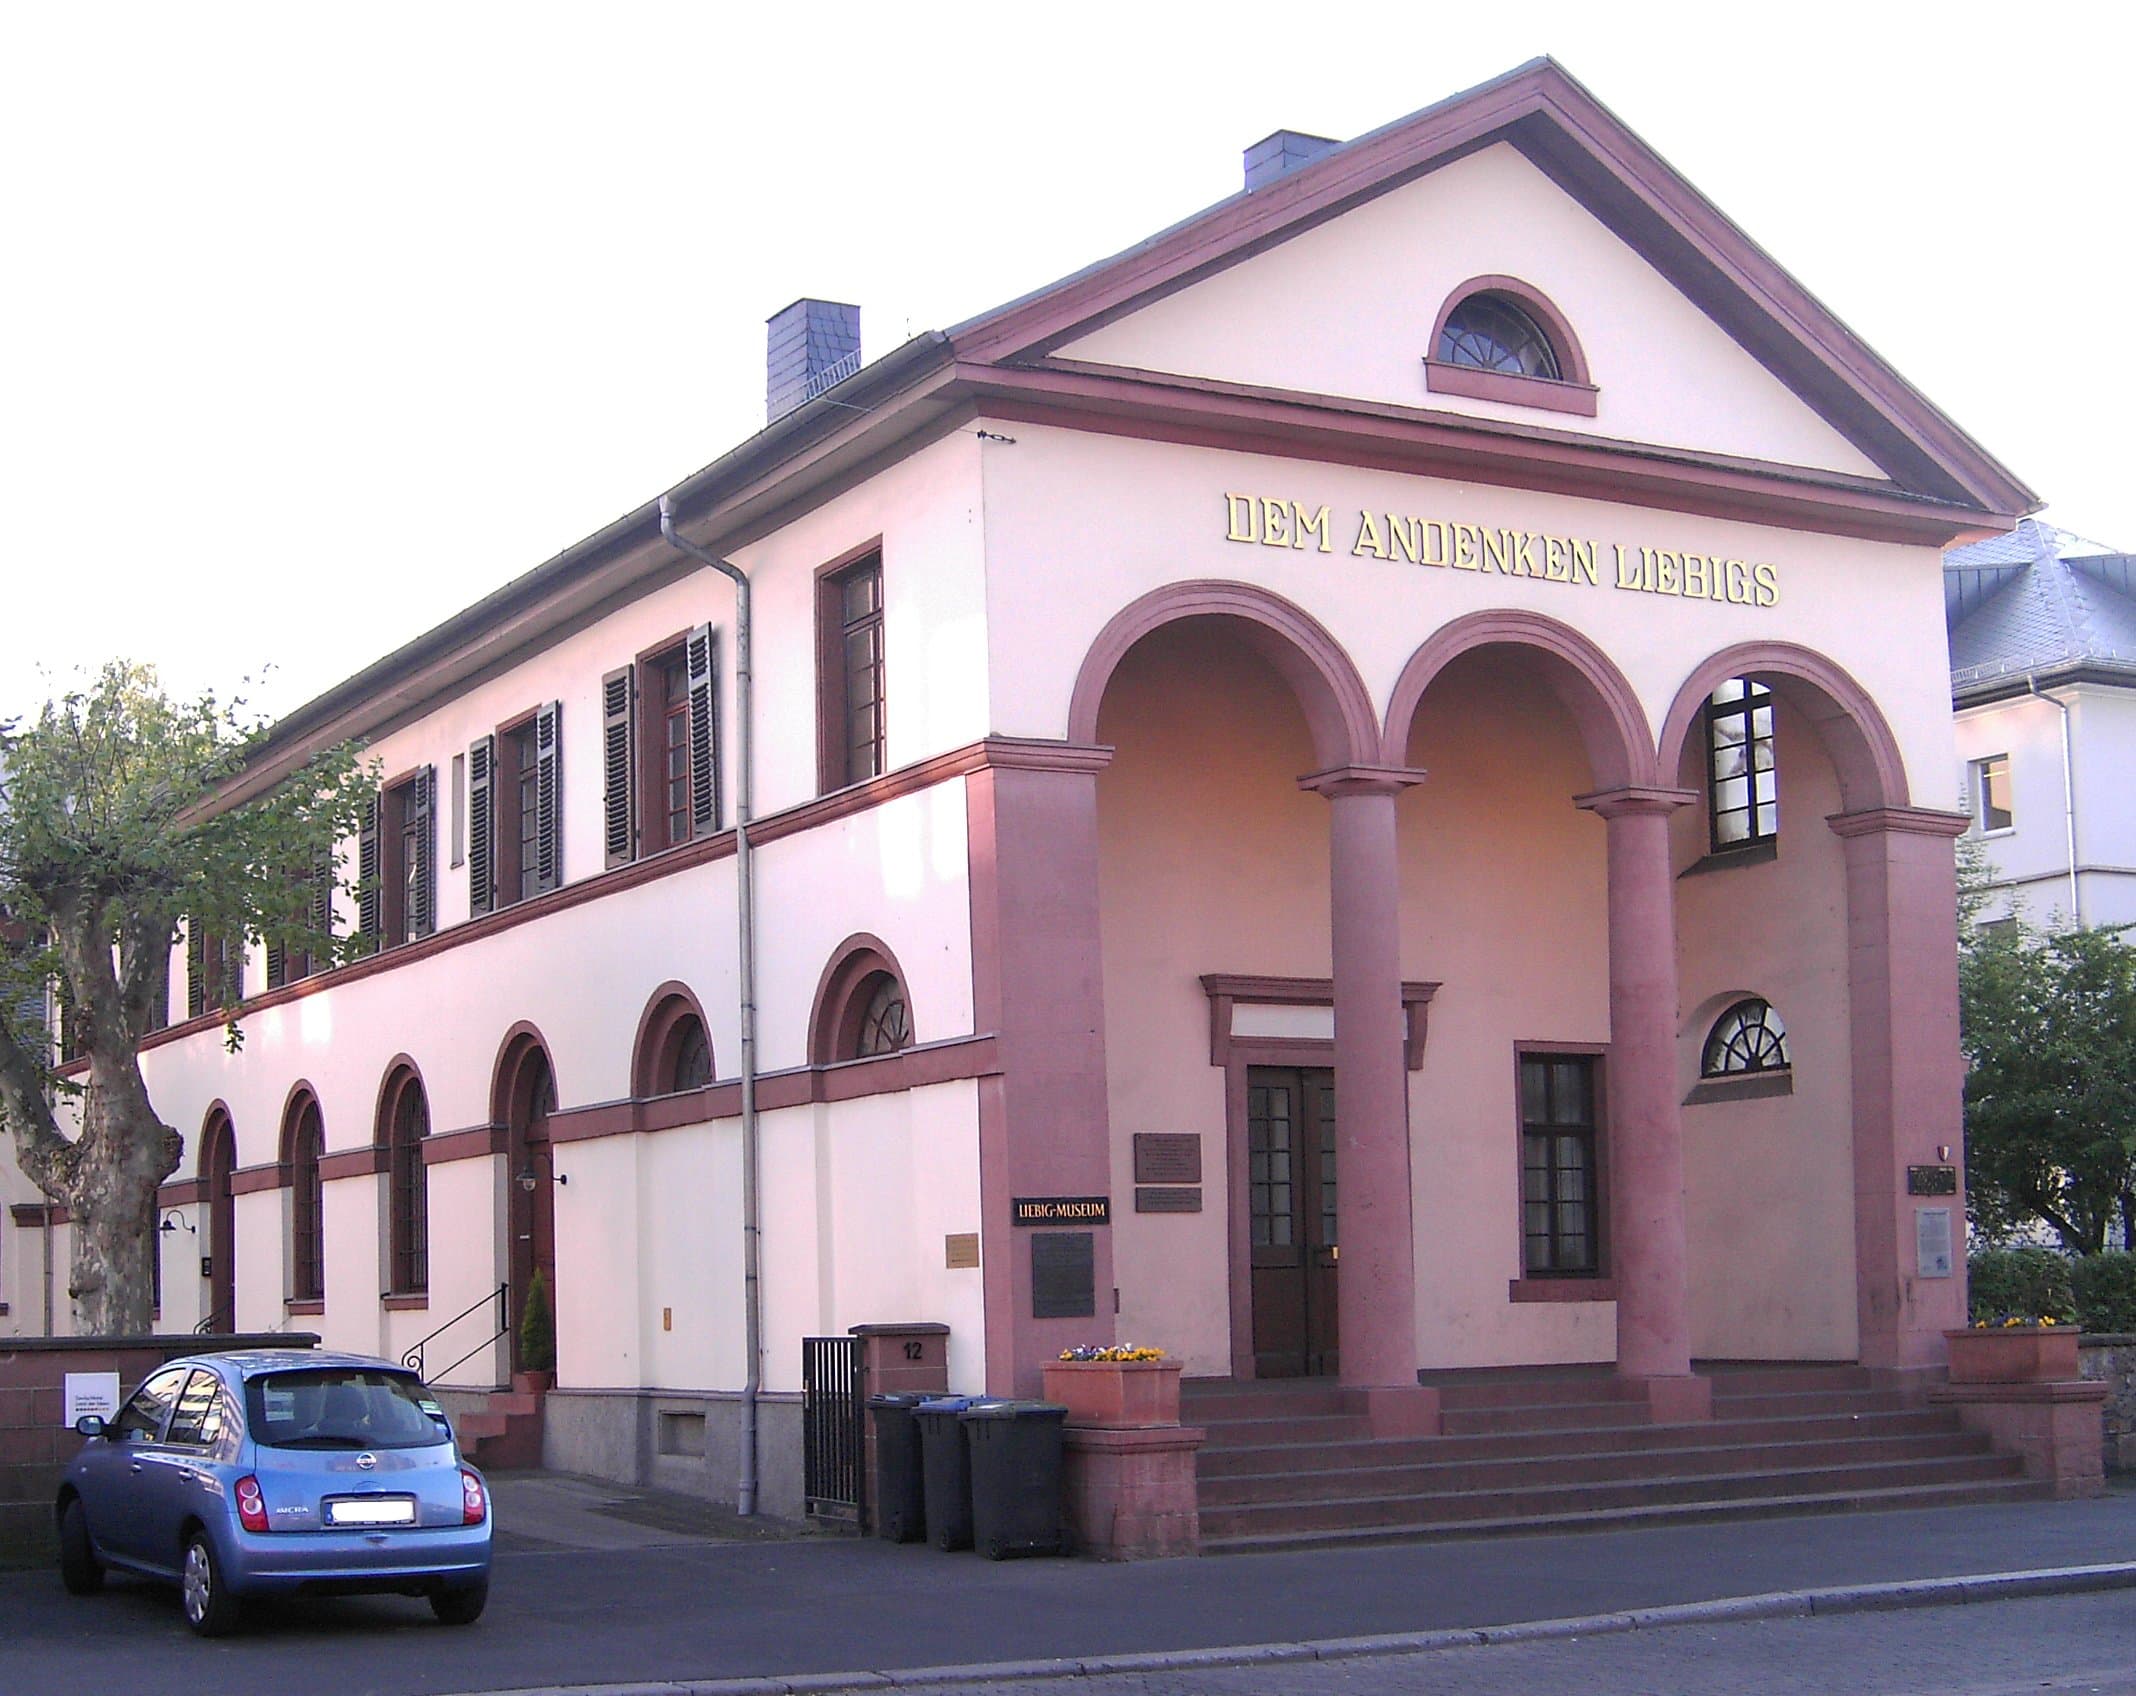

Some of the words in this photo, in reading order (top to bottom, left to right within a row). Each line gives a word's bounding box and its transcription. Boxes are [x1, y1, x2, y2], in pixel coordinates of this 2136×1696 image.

[1225, 491, 1333, 553] DEM
[1353, 509, 1600, 585] ANDENKEN
[1614, 542, 1782, 608] LIEBIGS
[1018, 1203, 1105, 1218] LIEBIG-MUSEUM
[903, 1342, 922, 1360] 12
